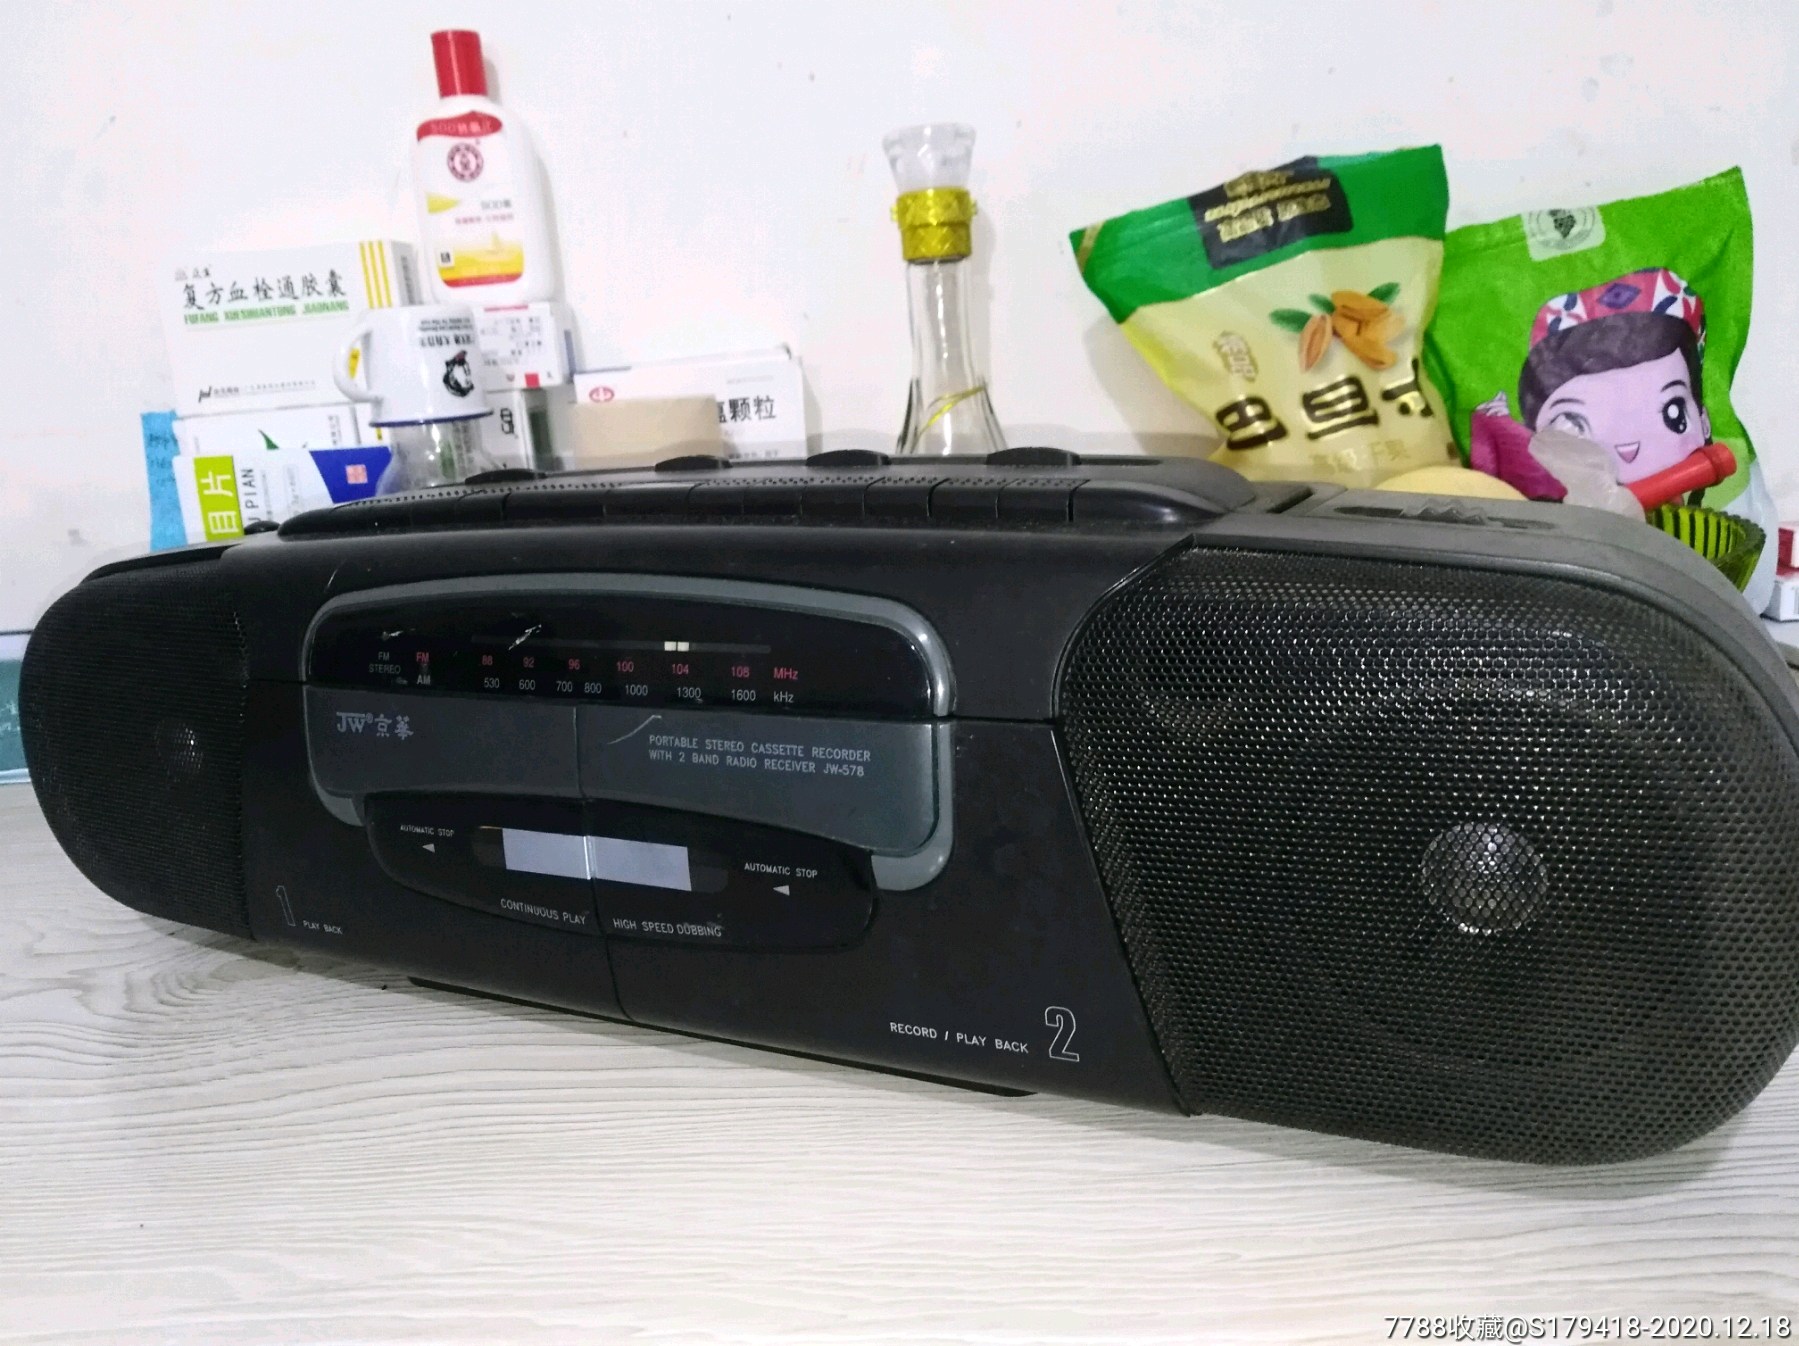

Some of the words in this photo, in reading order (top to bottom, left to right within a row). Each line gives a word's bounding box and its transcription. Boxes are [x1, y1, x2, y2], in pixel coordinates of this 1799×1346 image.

[183, 267, 347, 310] 复方血栓通胶囊
[368, 663, 401, 675] STEREO
[378, 651, 390, 662] FM
[416, 651, 430, 663] FM
[482, 655, 493, 666] 88
[523, 657, 535, 668] 92
[568, 659, 581, 671] 96
[616, 661, 634, 673] 100
[671, 663, 689, 675] 104
[731, 666, 750, 678] 108
[773, 667, 798, 681] MHz
[416, 674, 431, 686] AM
[484, 677, 499, 689] 530
[519, 679, 536, 691] 600
[556, 681, 573, 693] 700
[584, 682, 602, 694] 800
[625, 684, 648, 696] 1000
[676, 686, 701, 699] 1300
[731, 689, 756, 701] 1600
[773, 690, 794, 704] kHz
[649, 734, 698, 750] PORTABLE
[705, 738, 744, 753] STEREO
[751, 742, 804, 757] CASSETTE
[811, 746, 871, 762] RECORDER
[649, 750, 672, 762] WITH
[679, 752, 686, 763] 2
[692, 754, 719, 765] BAND
[726, 756, 757, 768] RADIO
[764, 758, 816, 773] RECEIVER
[823, 762, 865, 777] JW-578
[400, 824, 435, 836] AUTOMATIC
[438, 828, 455, 838] STOP
[744, 861, 791, 876] AUTOMATIC
[796, 867, 818, 879] STOP
[500, 898, 560, 921] CONTINUOUS
[562, 911, 586, 926] PLAY
[303, 920, 320, 931] PLAY
[324, 923, 343, 935] BACK
[613, 917, 637, 931] HIGH
[642, 921, 674, 934] SPEED
[676, 923, 722, 938] DUBBING
[889, 1021, 938, 1040] RECORD
[956, 1032, 987, 1047] PLAY
[995, 1038, 1029, 1054] BACK
[1044, 1005, 1080, 1062] 2
